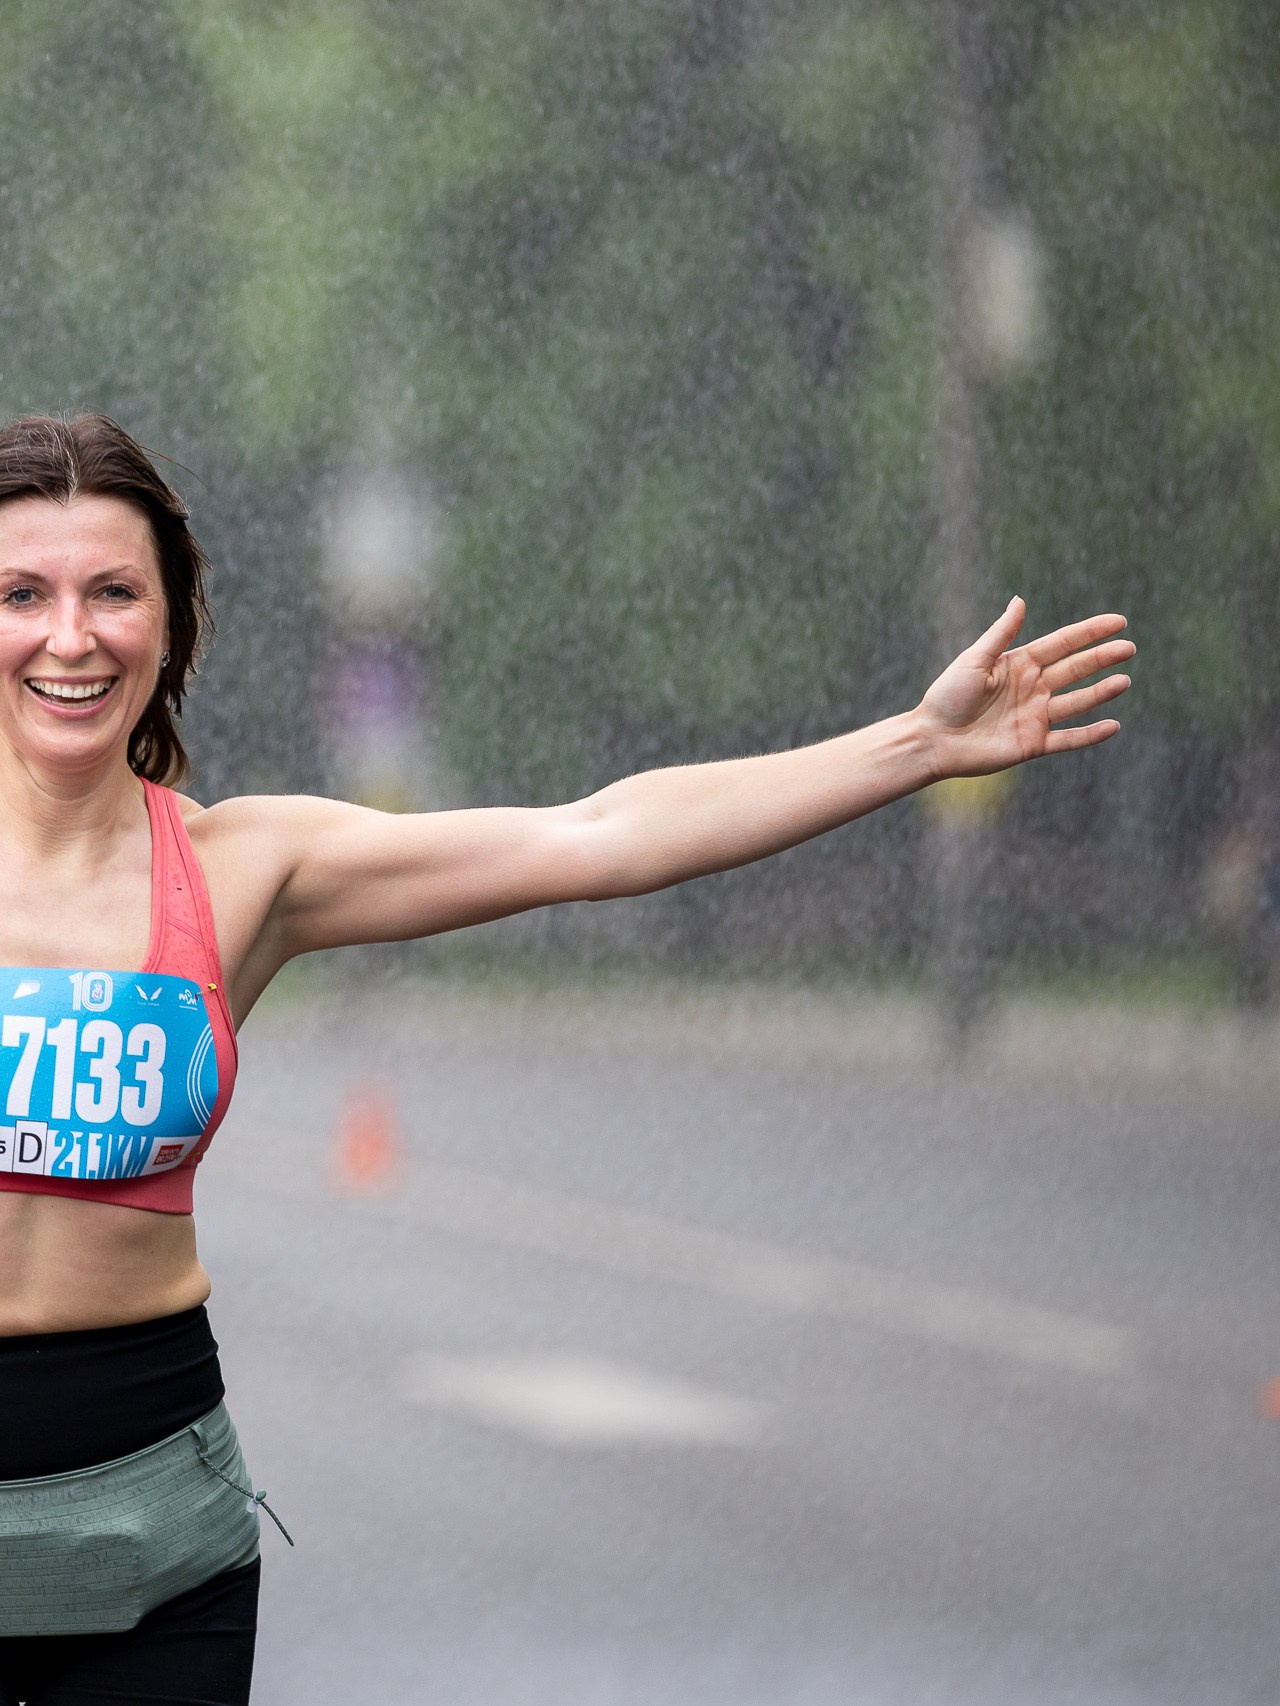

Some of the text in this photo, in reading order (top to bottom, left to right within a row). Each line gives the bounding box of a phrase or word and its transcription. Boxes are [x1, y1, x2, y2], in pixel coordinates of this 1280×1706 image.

[70, 972, 114, 1012] 10
[2, 1015, 167, 1126] 7133
[19, 1132, 42, 1163] D
